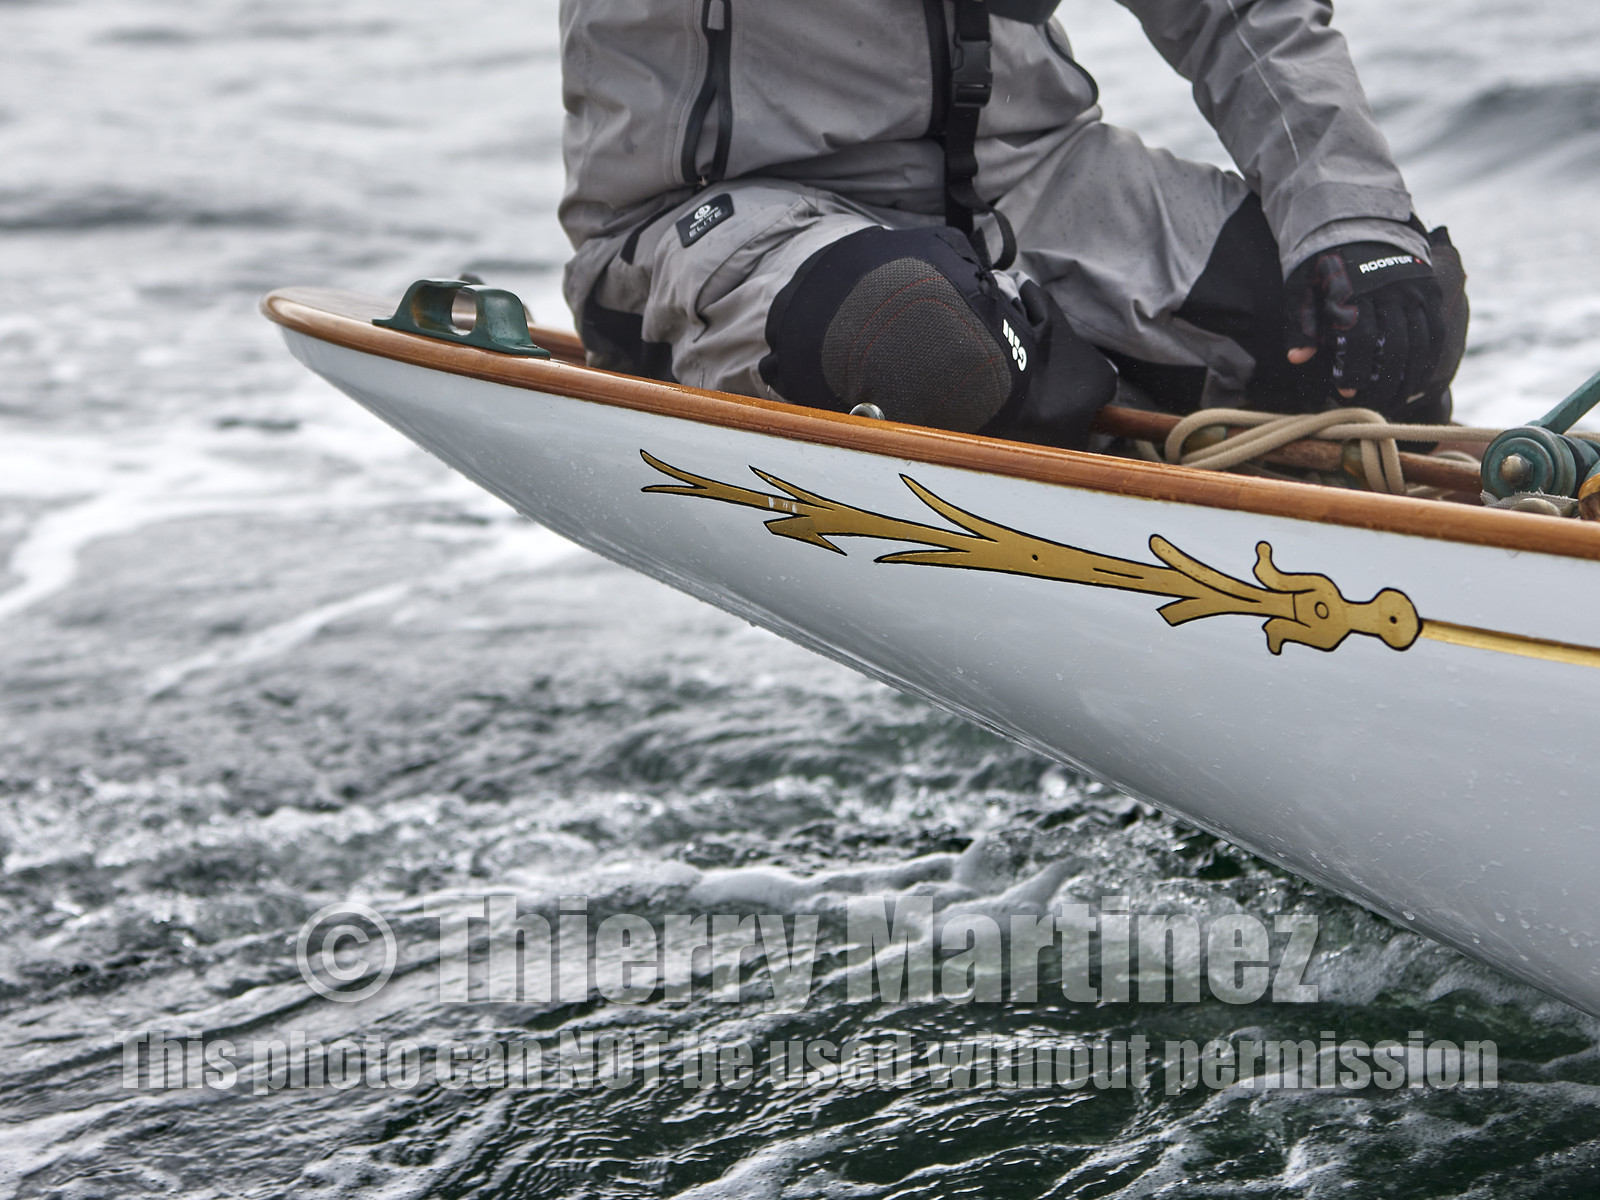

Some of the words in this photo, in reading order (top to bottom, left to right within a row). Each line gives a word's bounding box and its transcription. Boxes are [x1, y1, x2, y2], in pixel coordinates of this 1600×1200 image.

[689, 209, 722, 238] ELITE
[1359, 255, 1413, 274] ROOSTER
[1002, 318, 1028, 372] Gill
